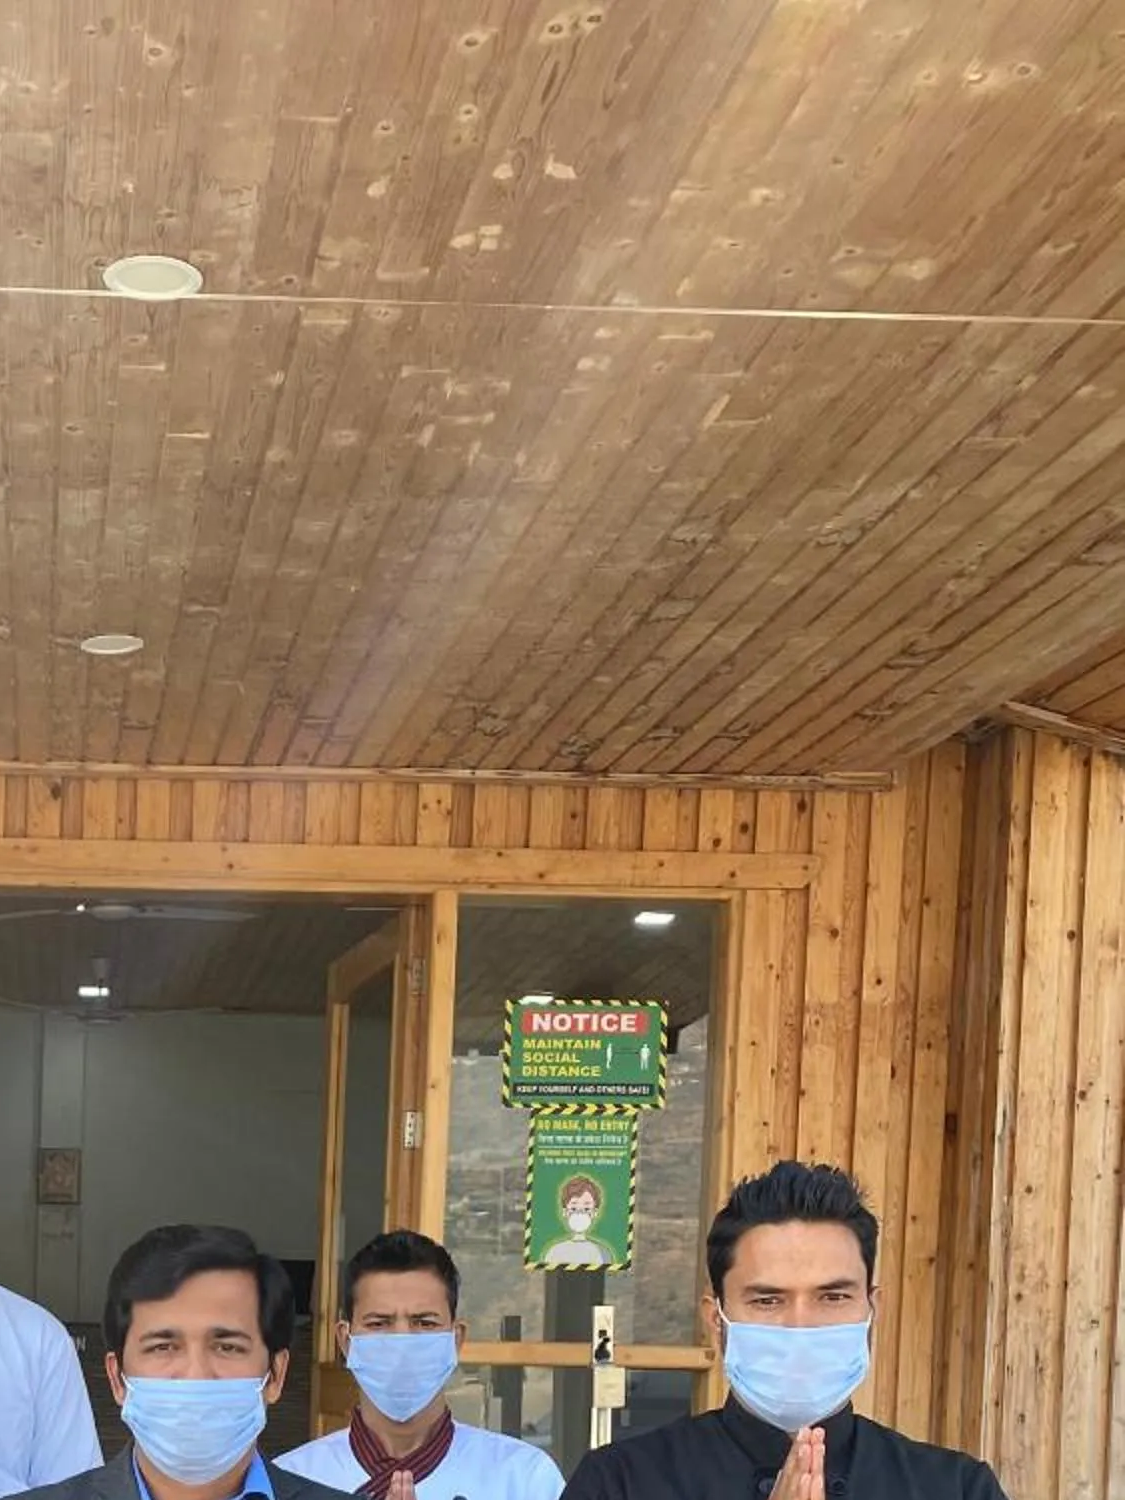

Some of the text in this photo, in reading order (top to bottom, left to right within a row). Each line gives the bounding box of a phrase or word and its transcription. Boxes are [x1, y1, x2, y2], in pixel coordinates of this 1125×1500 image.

[532, 1013, 638, 1033] NOTICE
[522, 1039, 602, 1050] MAINTAIN
[522, 1052, 582, 1063] SOCIAL
[522, 1066, 602, 1077] DISTANCE
[517, 1085, 538, 1093] KEEP
[539, 1085, 577, 1093] YOURSELF
[579, 1086, 596, 1094] AND
[597, 1086, 626, 1094] OTHERS
[538, 1119, 551, 1130] NO
[585, 1120, 598, 1131] NO
[601, 1120, 629, 1132] ENTRY
